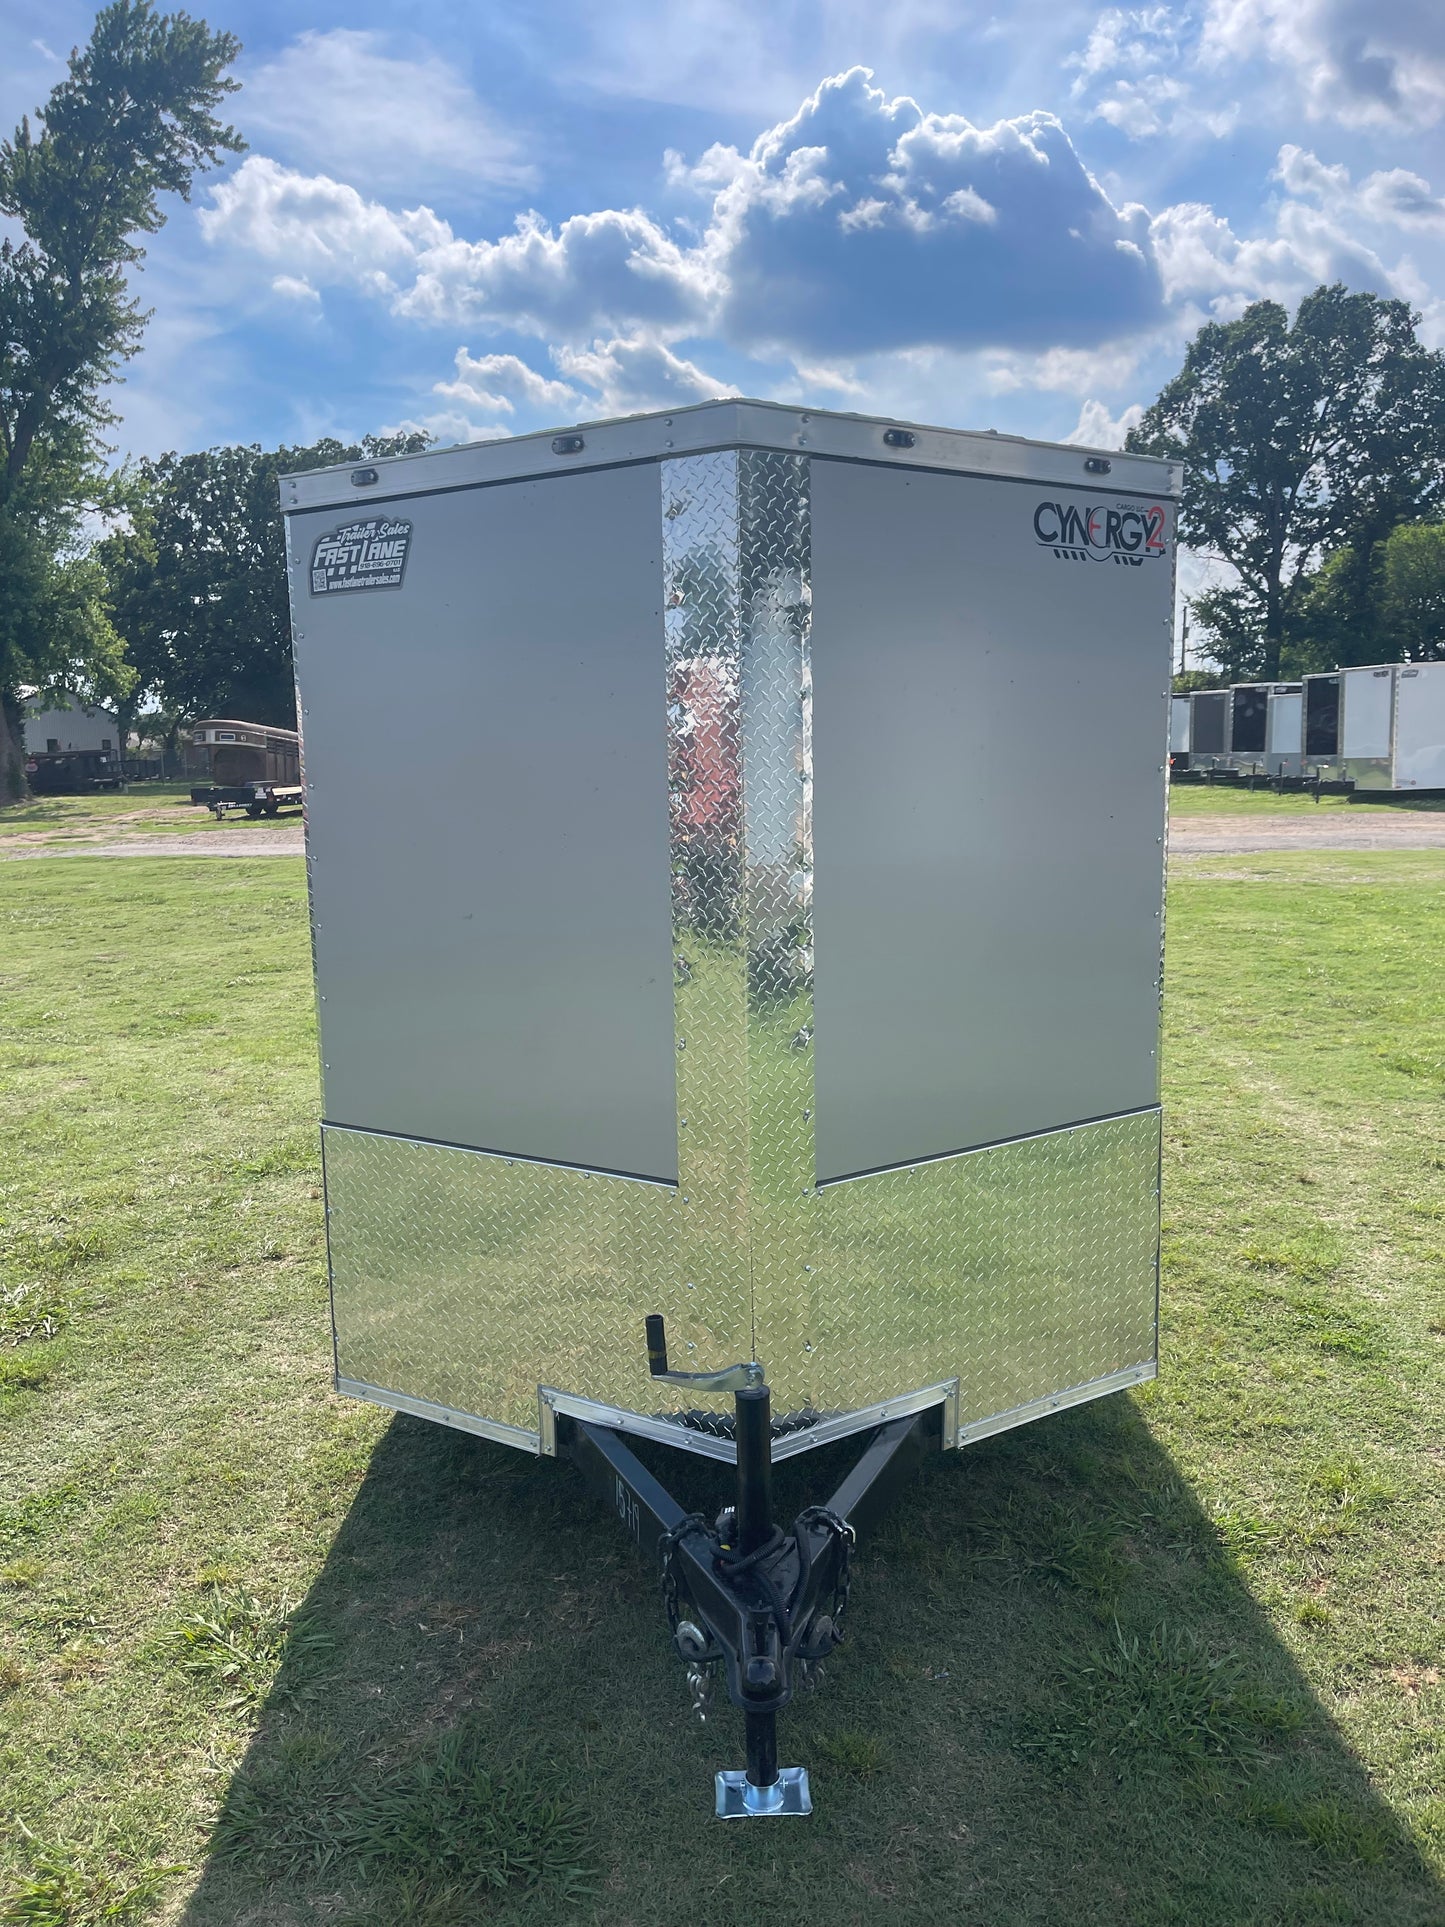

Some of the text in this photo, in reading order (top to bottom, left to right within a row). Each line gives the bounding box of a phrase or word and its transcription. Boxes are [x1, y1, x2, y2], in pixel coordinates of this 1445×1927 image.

[1116, 503, 1135, 511] CARGO
[339, 522, 410, 543] Trailer Sales
[313, 540, 407, 567] FAST LANE
